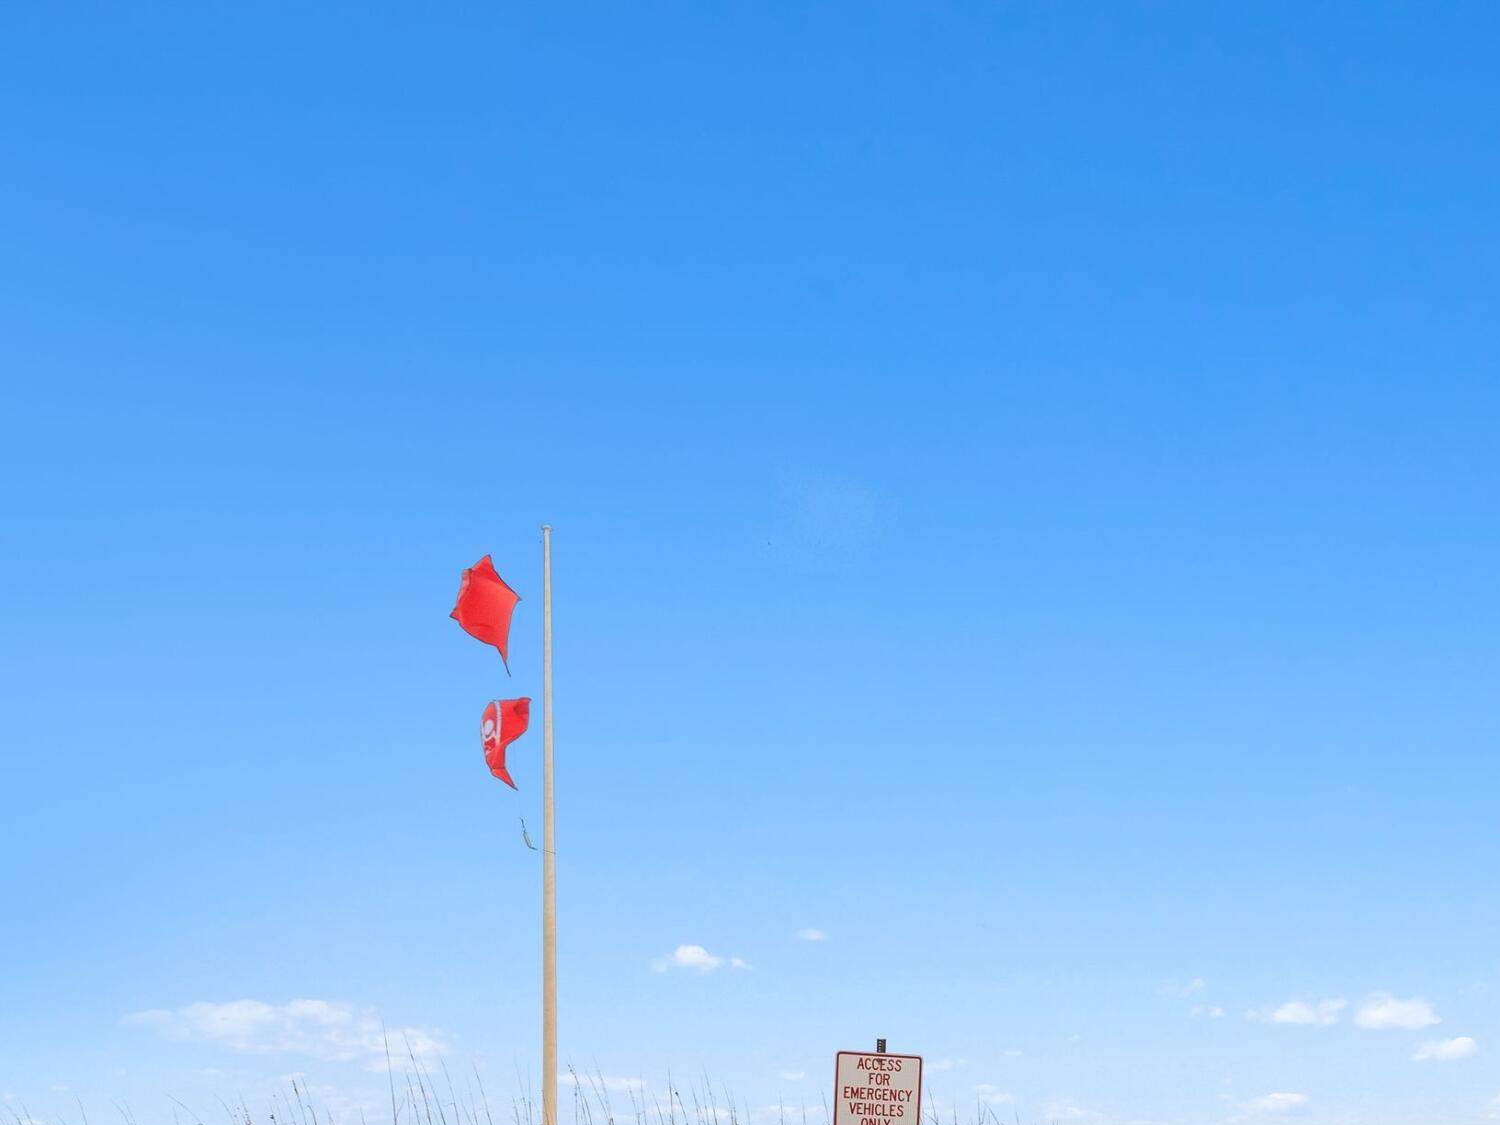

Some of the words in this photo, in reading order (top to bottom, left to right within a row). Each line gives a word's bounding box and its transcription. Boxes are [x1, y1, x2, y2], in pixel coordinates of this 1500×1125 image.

[857, 1057, 902, 1072] ACCESS
[868, 1072, 891, 1086] FOR
[843, 1086, 912, 1102] EMERGENCY
[849, 1102, 904, 1117] VEHICLES
